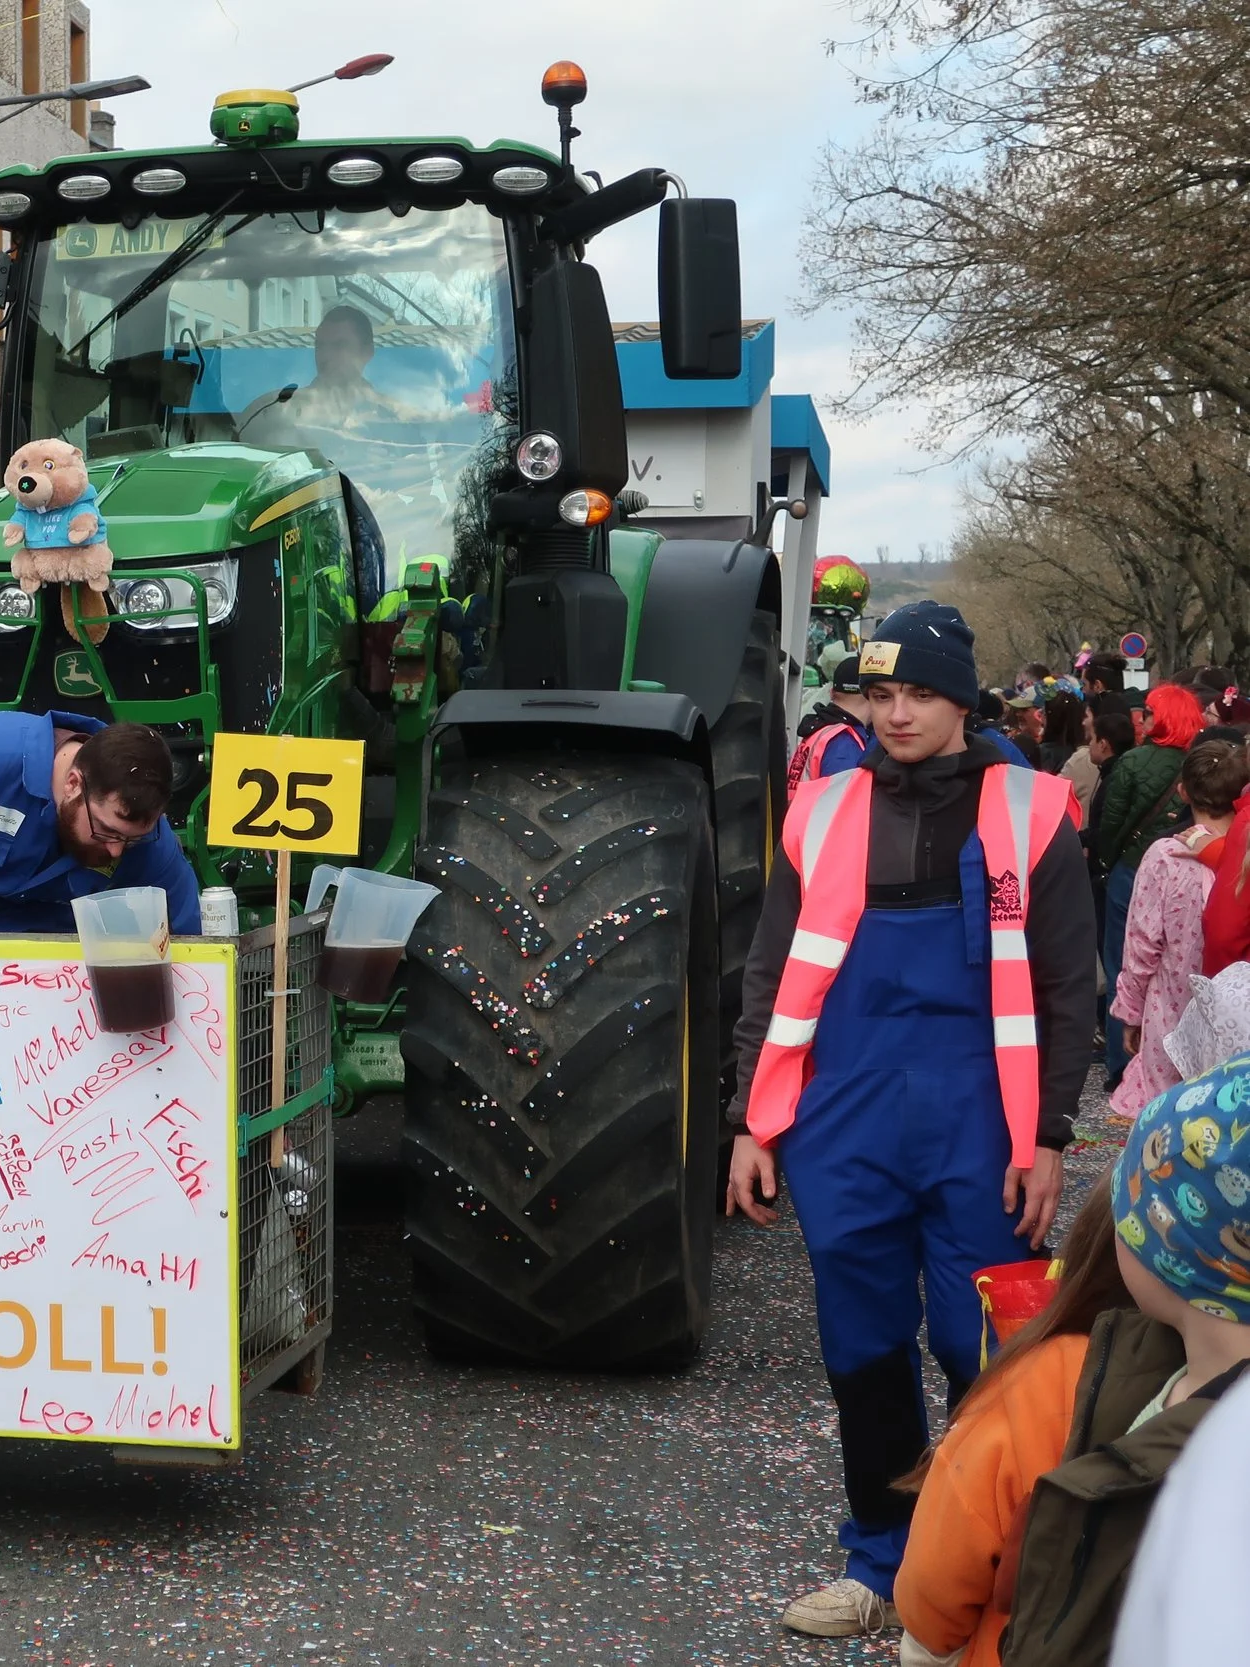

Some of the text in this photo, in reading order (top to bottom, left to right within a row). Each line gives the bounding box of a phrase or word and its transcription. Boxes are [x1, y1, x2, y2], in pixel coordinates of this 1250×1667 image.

[110, 223, 171, 255] ANDY
[231, 767, 334, 841] 25
[27, 1038, 156, 1126] Vanessa
[58, 1117, 134, 1175] Basti
[71, 1232, 147, 1277] Anna
[19, 1384, 222, 1438] Leo Michel
